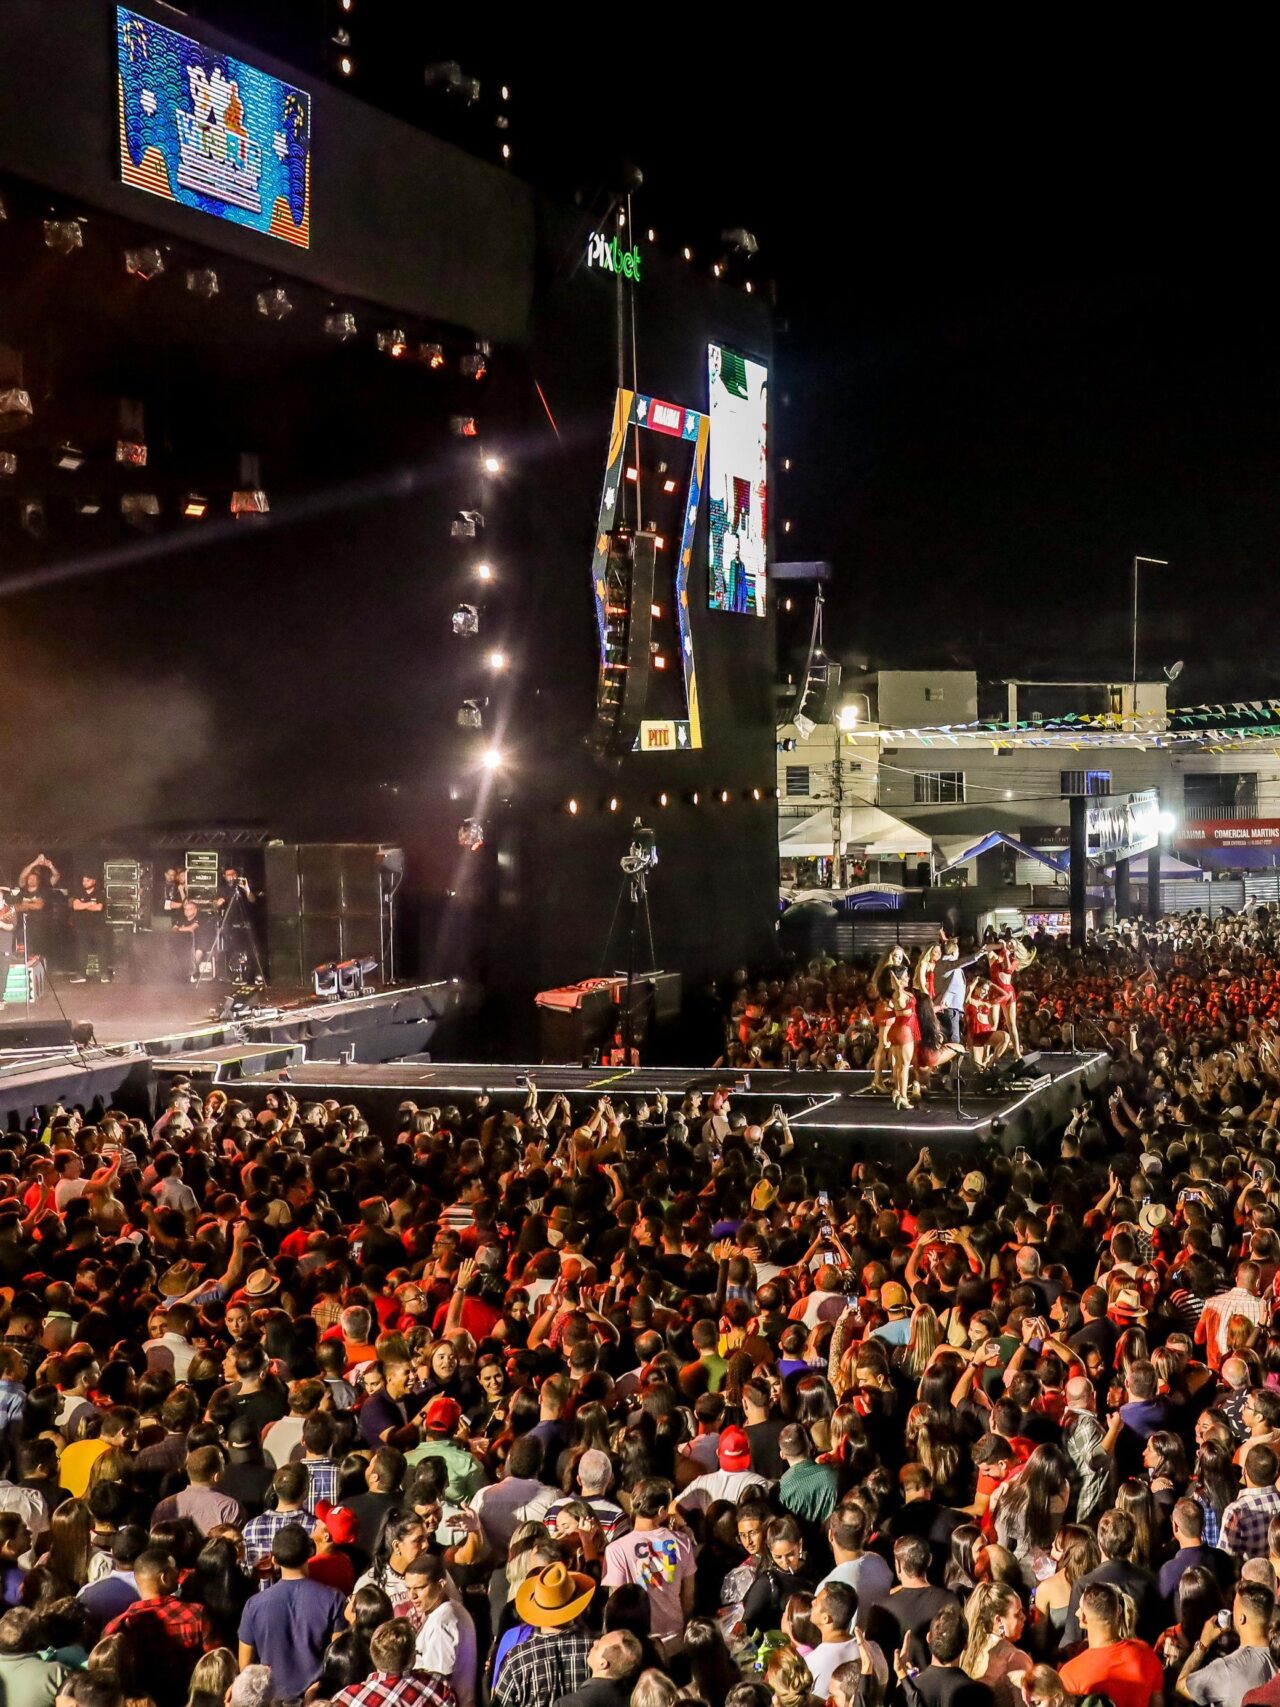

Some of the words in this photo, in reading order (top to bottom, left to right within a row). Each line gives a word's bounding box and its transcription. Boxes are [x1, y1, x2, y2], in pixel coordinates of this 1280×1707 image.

[587, 231, 641, 282] Pixbet
[1214, 829, 1250, 839] COMERCIAL
[1251, 828, 1280, 838] MARTINS
